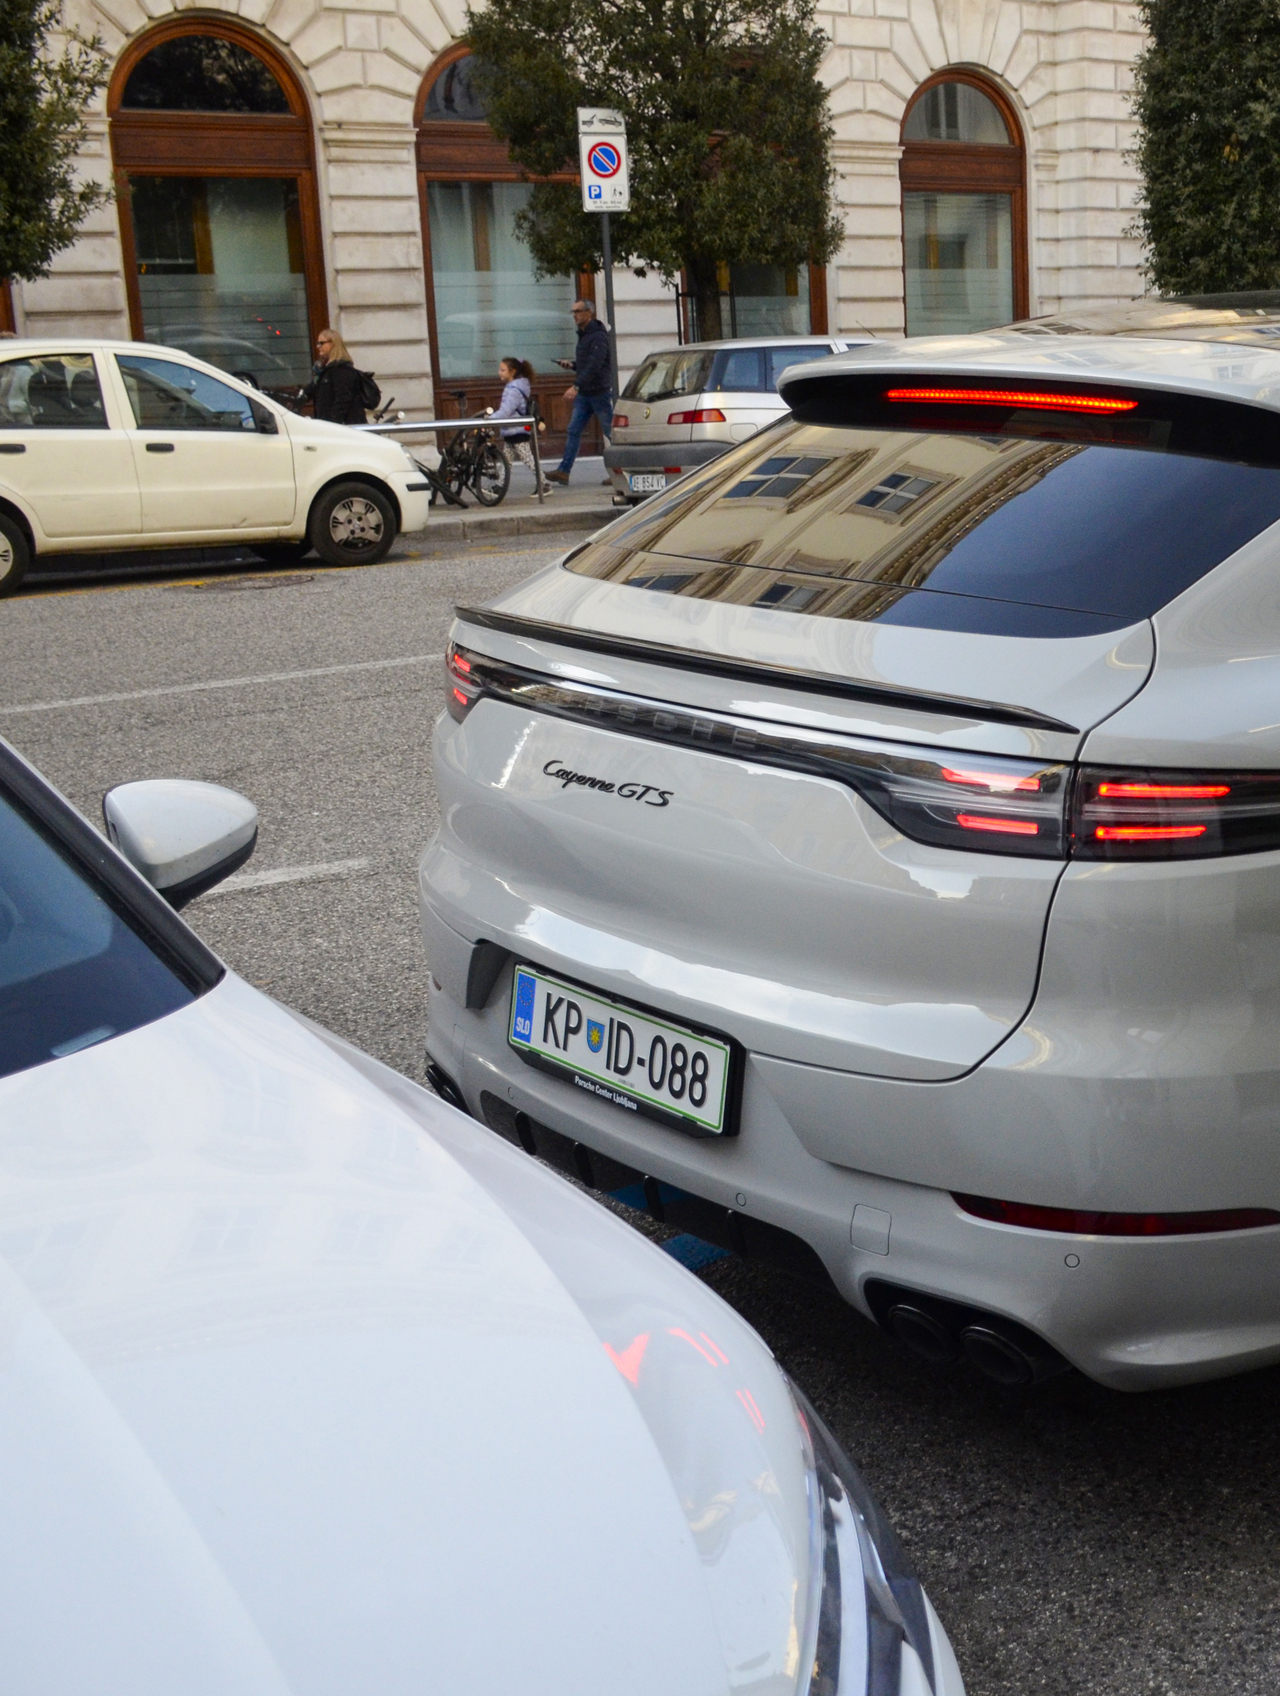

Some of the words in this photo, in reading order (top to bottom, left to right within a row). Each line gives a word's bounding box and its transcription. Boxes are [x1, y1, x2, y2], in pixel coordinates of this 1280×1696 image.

[591, 186, 600, 198] P
[543, 760, 615, 793] Cayenne
[617, 783, 674, 807] GTS
[516, 1016, 530, 1035] SLO
[542, 991, 583, 1051] KP
[605, 1016, 709, 1108] ID-088
[575, 1075, 595, 1092] Porsche
[595, 1085, 613, 1100] Center
[613, 1092, 638, 1110] Ljubljana
